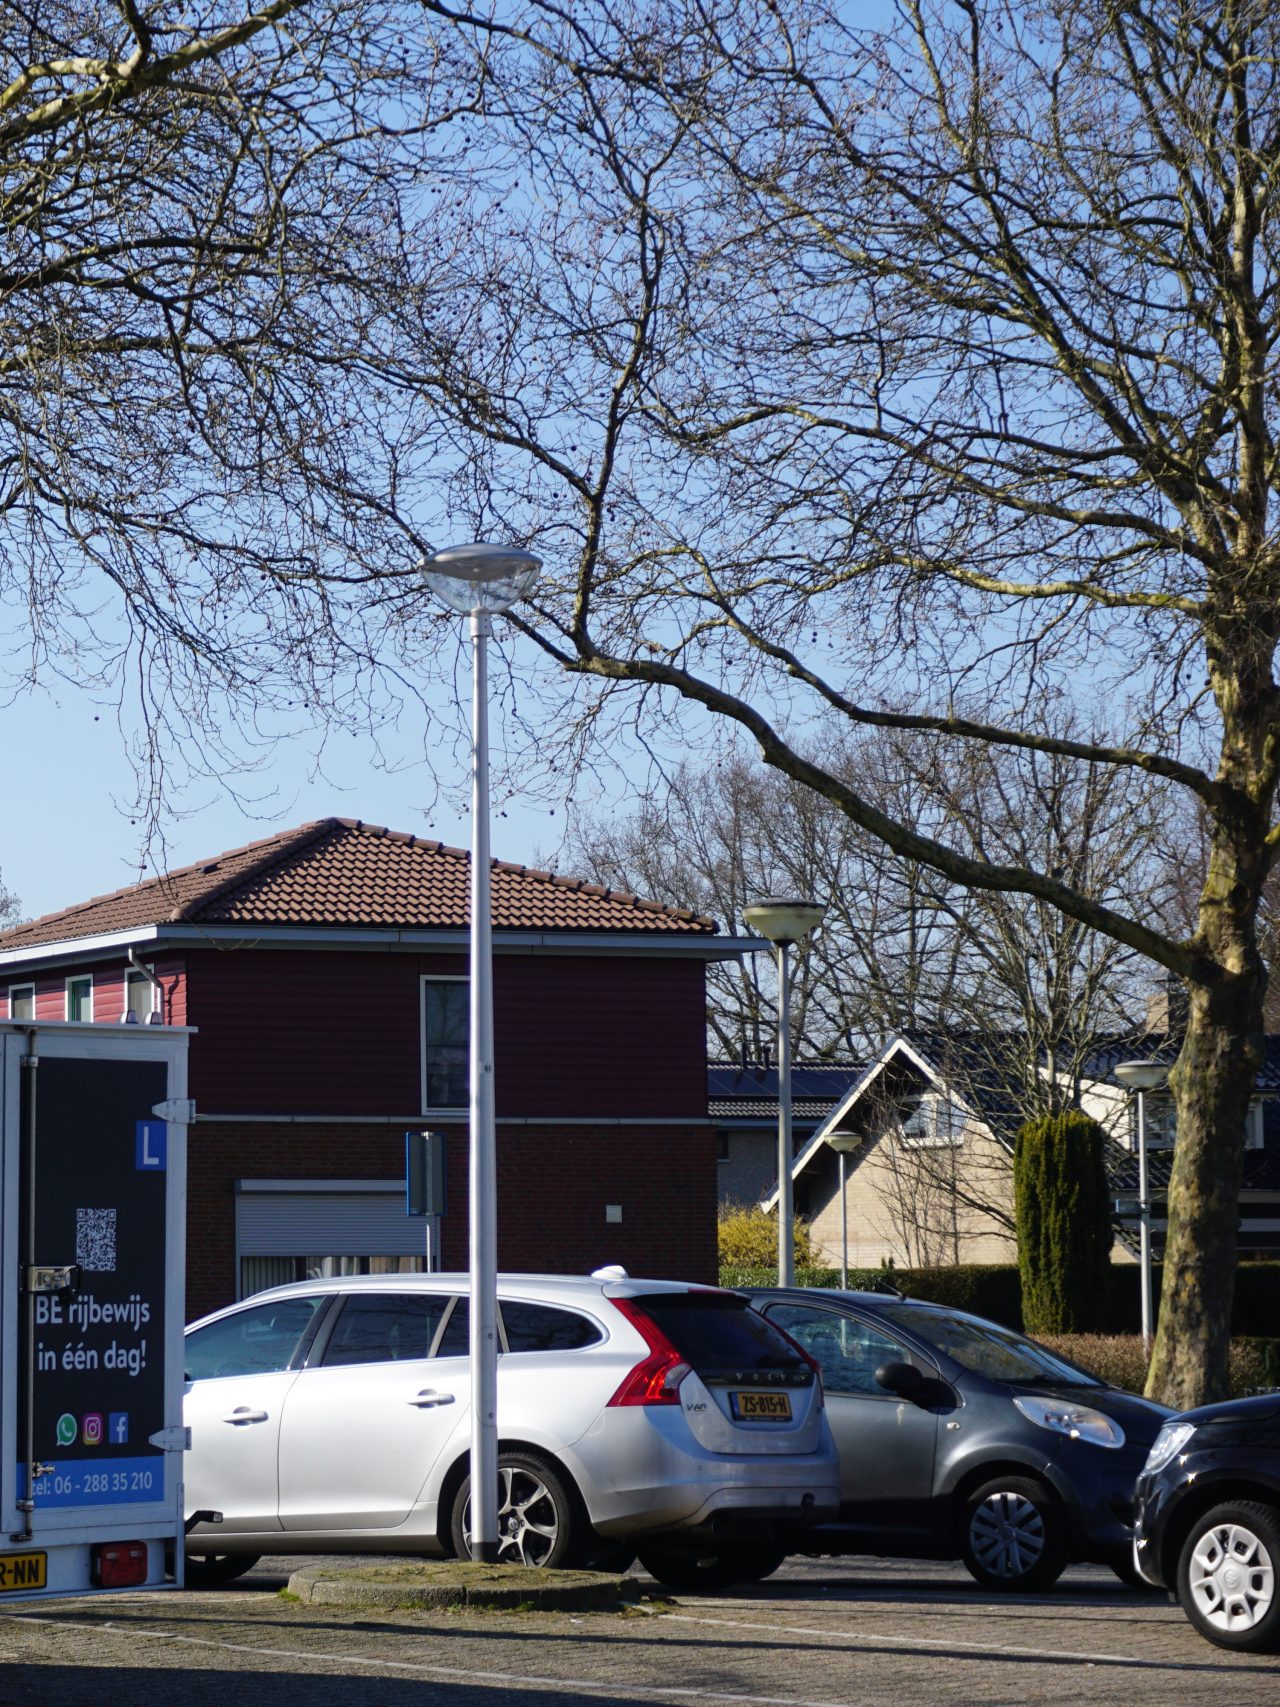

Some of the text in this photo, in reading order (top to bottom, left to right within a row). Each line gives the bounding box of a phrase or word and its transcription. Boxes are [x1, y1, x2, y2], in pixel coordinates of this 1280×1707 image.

[143, 1126, 160, 1165] L
[36, 1294, 151, 1333] BE rijbewijs
[38, 1340, 147, 1377] in één dag!
[54, 1476, 72, 1494] 06
[83, 1474, 109, 1493] 288
[112, 1473, 128, 1491] 35
[131, 1471, 153, 1490] 210
